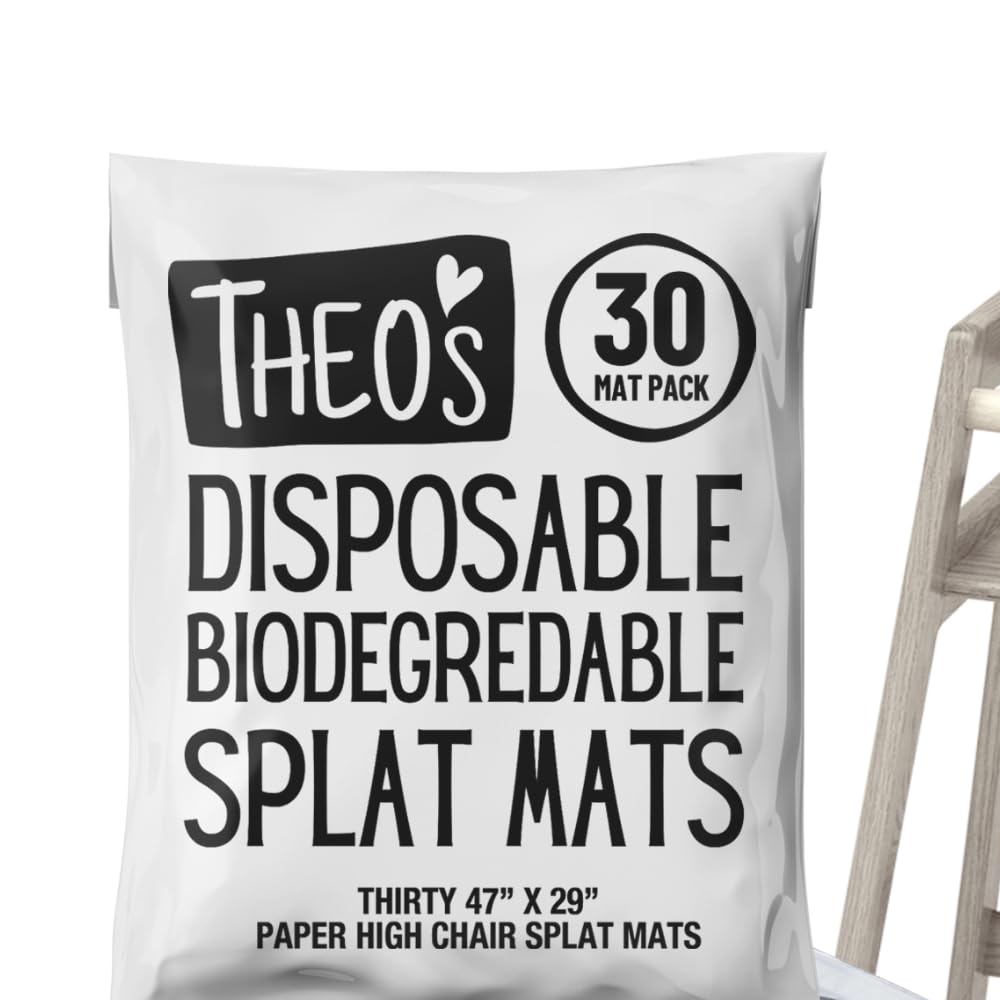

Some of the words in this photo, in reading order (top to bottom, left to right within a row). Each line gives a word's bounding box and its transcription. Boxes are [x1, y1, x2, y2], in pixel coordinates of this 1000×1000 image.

[593, 270, 706, 366] 30
[593, 373, 643, 402] MAT
[648, 373, 710, 402] PACK
[187, 472, 743, 593] DISPOSABLE
[186, 611, 744, 704] BIODEGREDABLE
[184, 728, 473, 848] SPLAT
[506, 728, 745, 848] MATS
[256, 921, 347, 950] PAPER
[357, 921, 422, 950] HIGH
[431, 921, 517, 950] CHAIR
[525, 921, 614, 950] SPLAT
[624, 921, 702, 950] MATS
[357, 887, 458, 915] THIRTY
[523, 887, 542, 915] X
